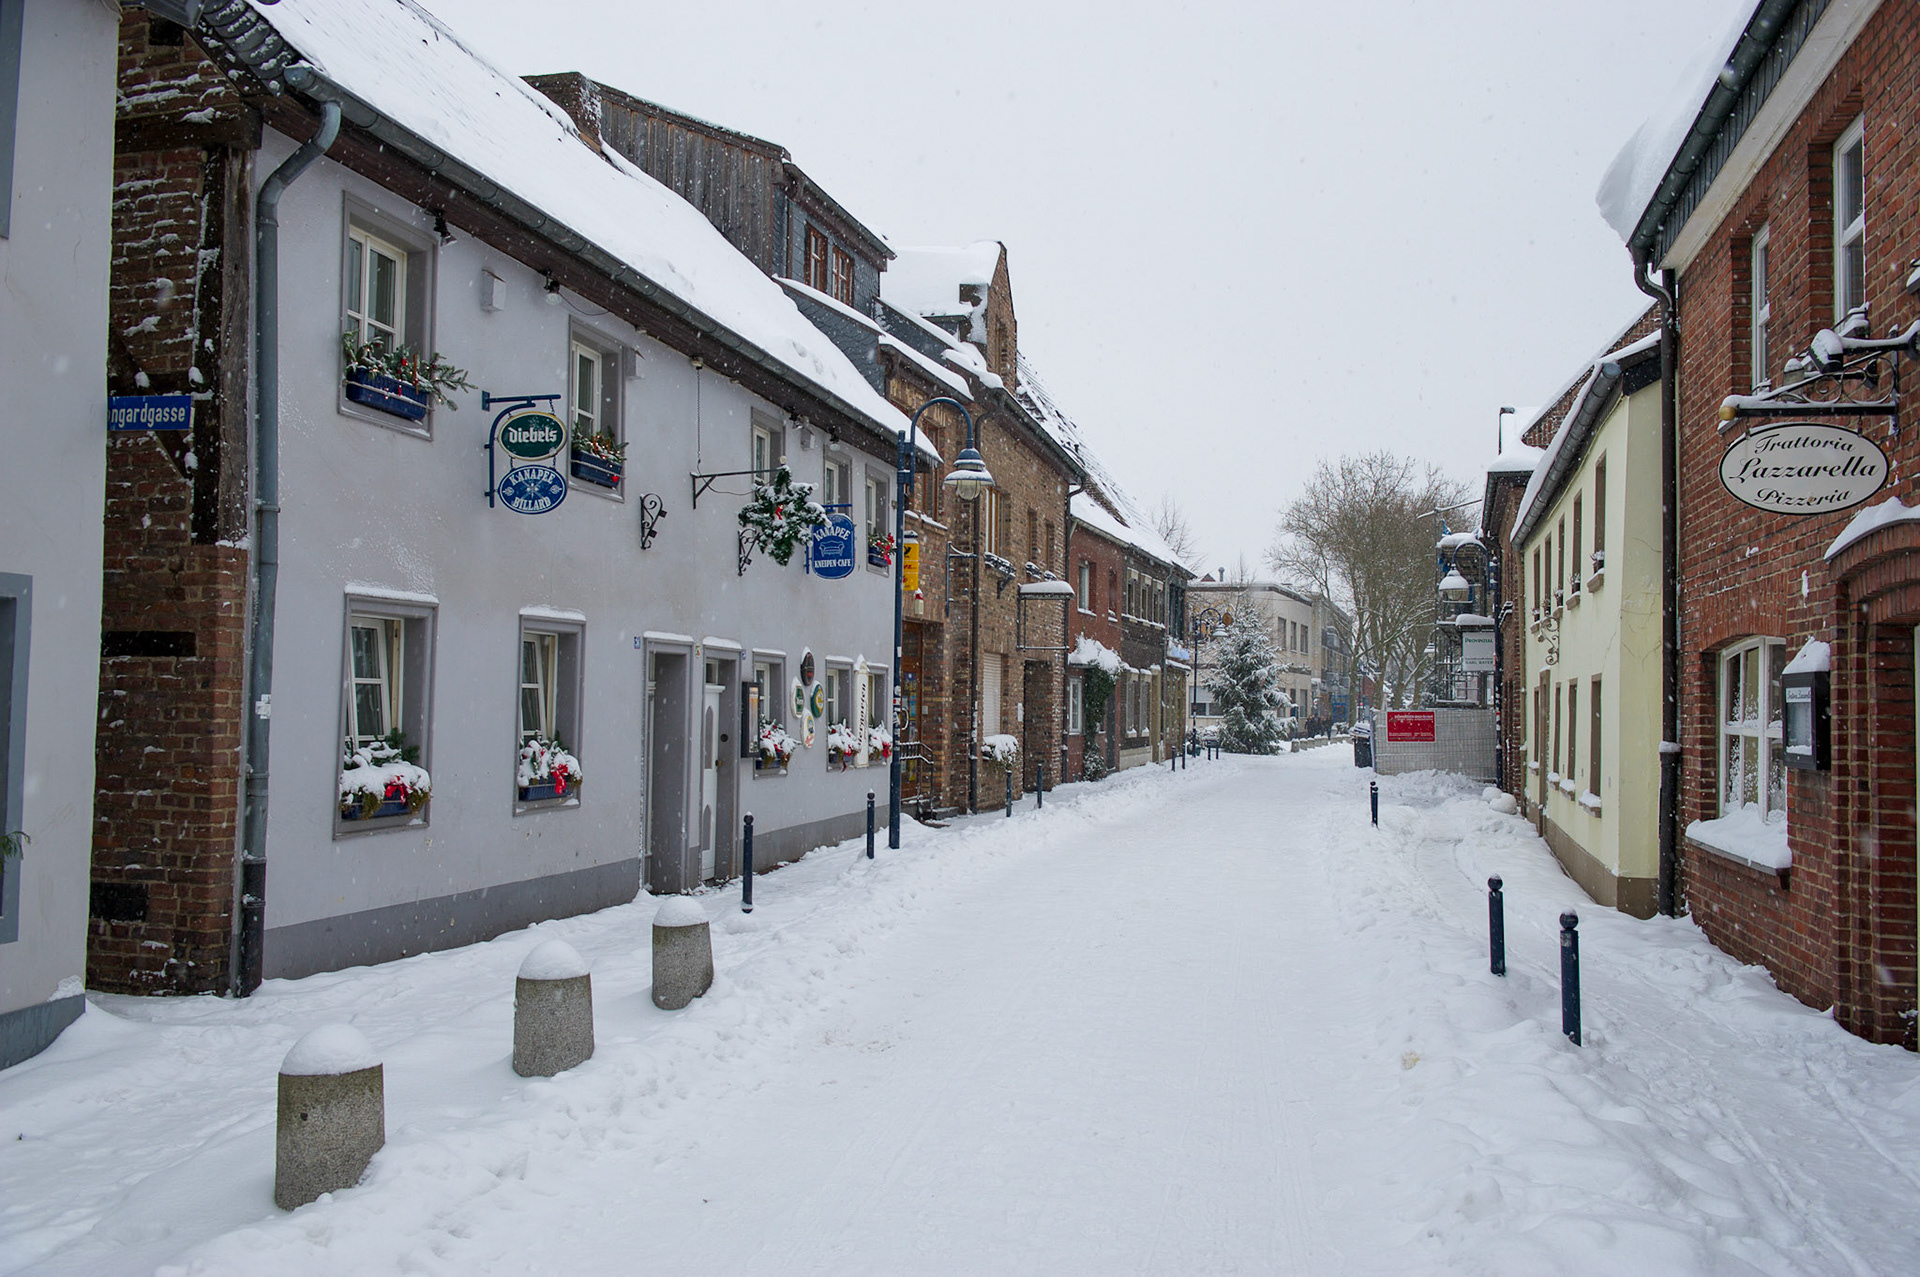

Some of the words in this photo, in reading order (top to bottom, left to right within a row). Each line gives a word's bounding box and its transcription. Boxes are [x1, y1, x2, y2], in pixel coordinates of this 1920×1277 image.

[108, 403, 185, 428] ngardgasse
[1755, 433, 1856, 454] Trattoria
[509, 469, 556, 486] KANAPEE
[1729, 456, 1880, 483] Lazzarella
[512, 496, 551, 510] BILLARD
[1753, 487, 1853, 507] Pizzeria
[813, 526, 851, 541] KANAPEE
